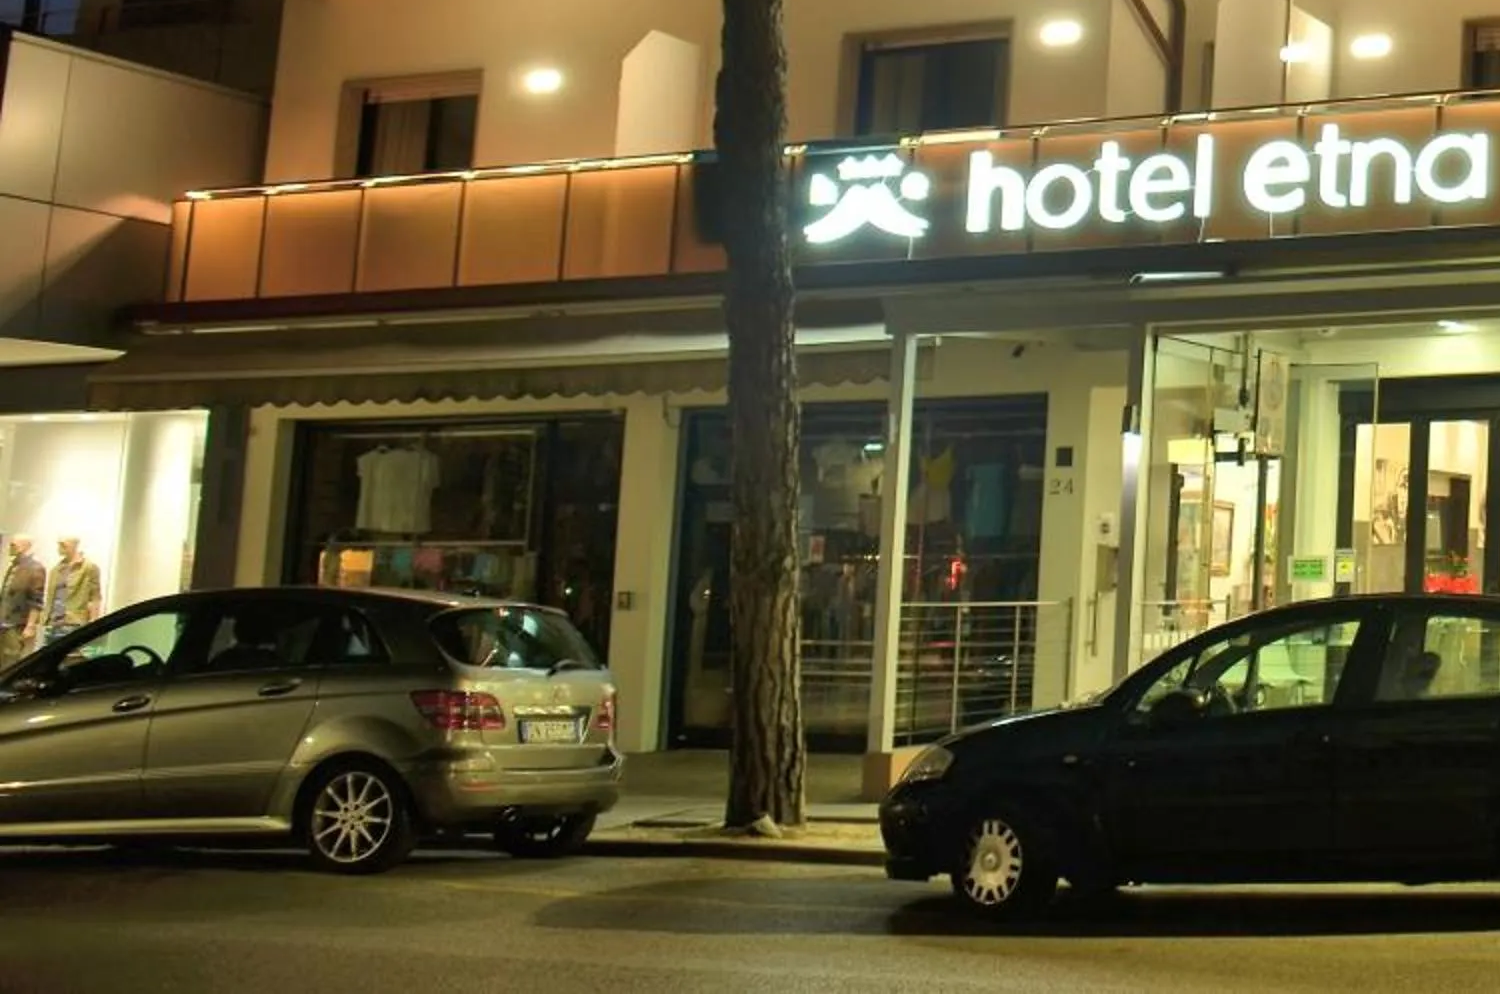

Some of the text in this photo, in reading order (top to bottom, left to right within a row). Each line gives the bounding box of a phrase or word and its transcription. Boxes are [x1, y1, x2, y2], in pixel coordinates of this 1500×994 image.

[966, 123, 1488, 232] hotel etna
[1049, 478, 1073, 495] 24
